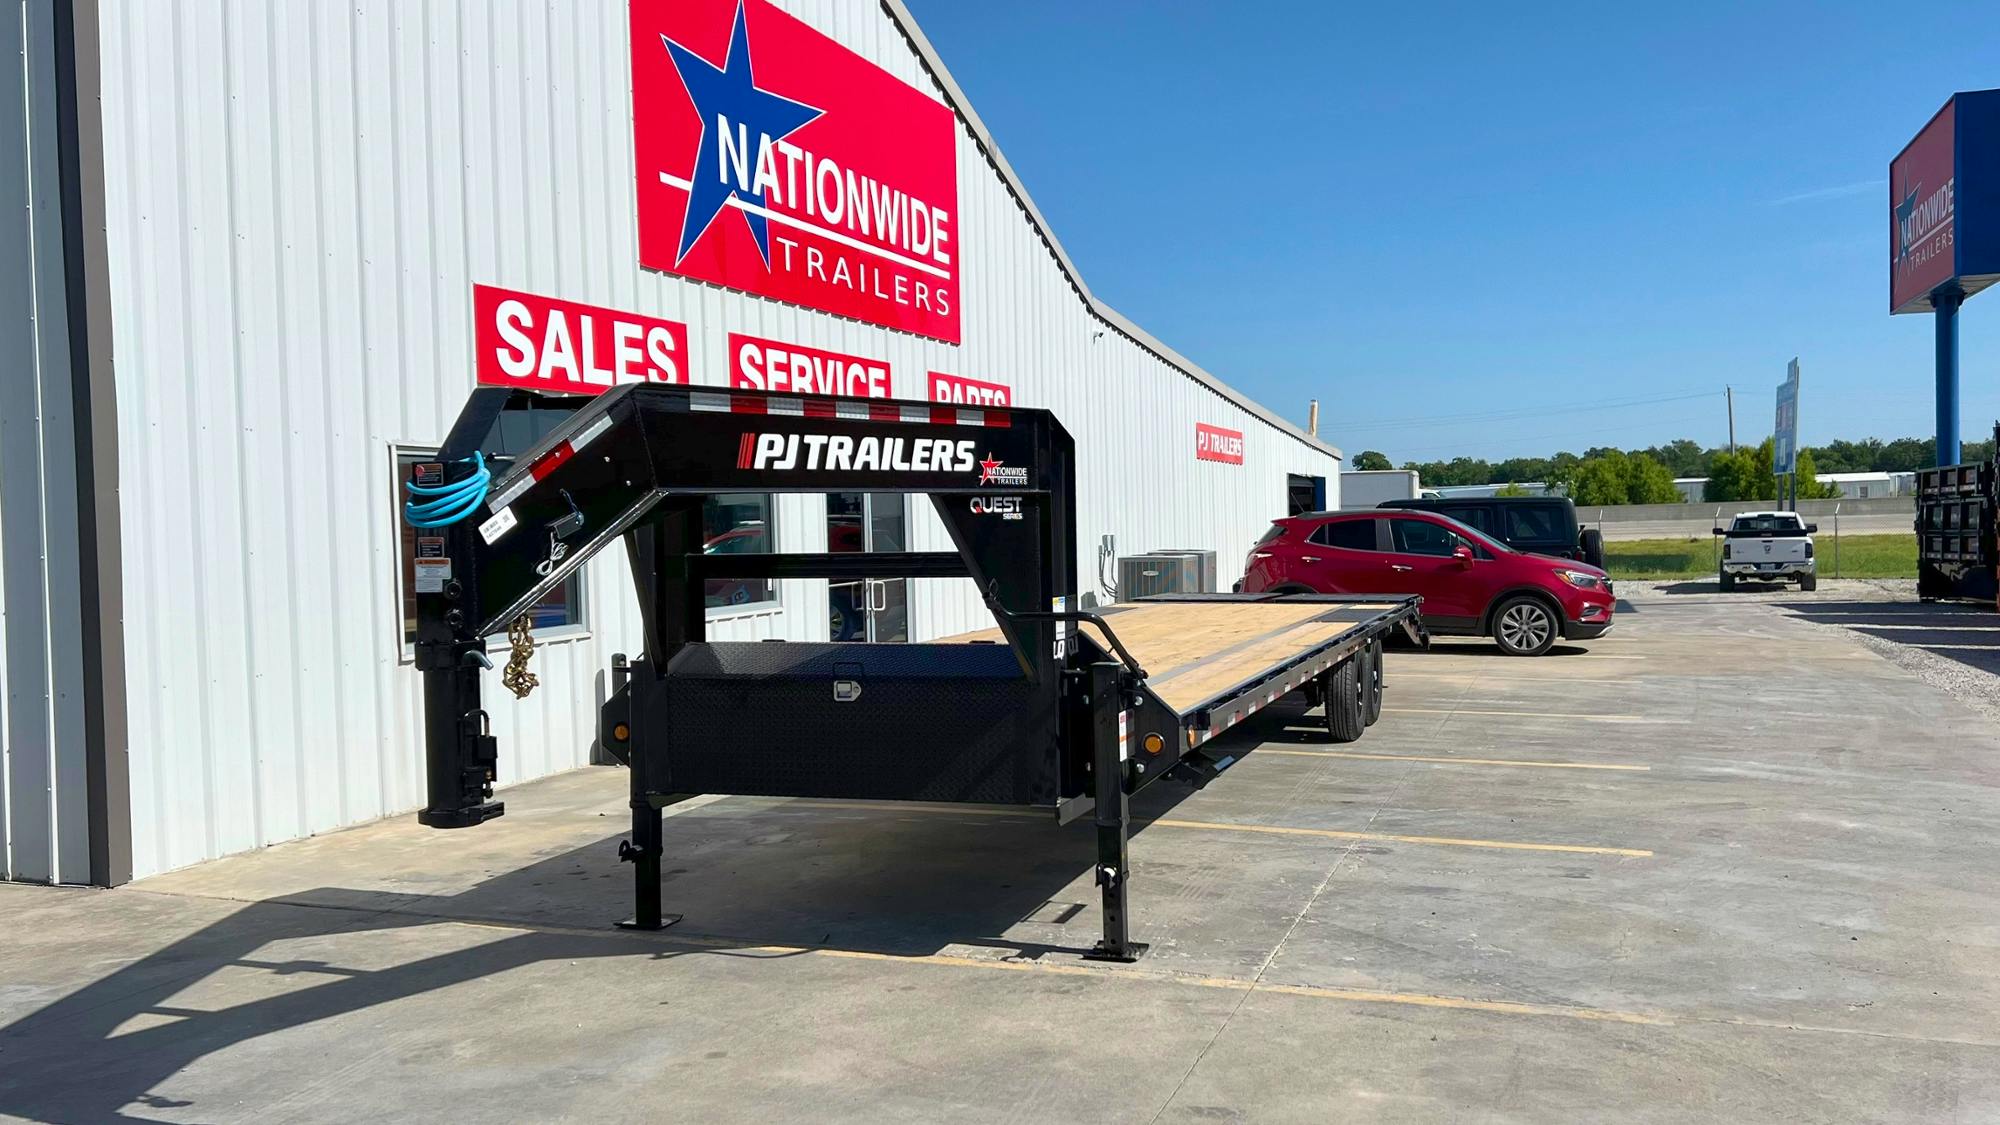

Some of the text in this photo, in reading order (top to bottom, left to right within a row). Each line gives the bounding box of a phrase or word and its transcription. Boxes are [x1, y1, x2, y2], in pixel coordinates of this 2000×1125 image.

[718, 113, 950, 265] NATIONWIDE
[1901, 177, 1954, 249] NATIONWIDE
[1910, 227, 1954, 272] TRAILERS
[776, 237, 950, 316] TRAILERS
[496, 300, 677, 385] SALES
[739, 343, 885, 398] SERVICE
[754, 433, 975, 472] PJ TRAILERS
[1198, 431, 1242, 457] PJ TRAILERS
[987, 467, 1028, 476] NATIONWIDE
[997, 477, 1028, 485] TRAILERS
[970, 497, 1022, 514] QUEST
